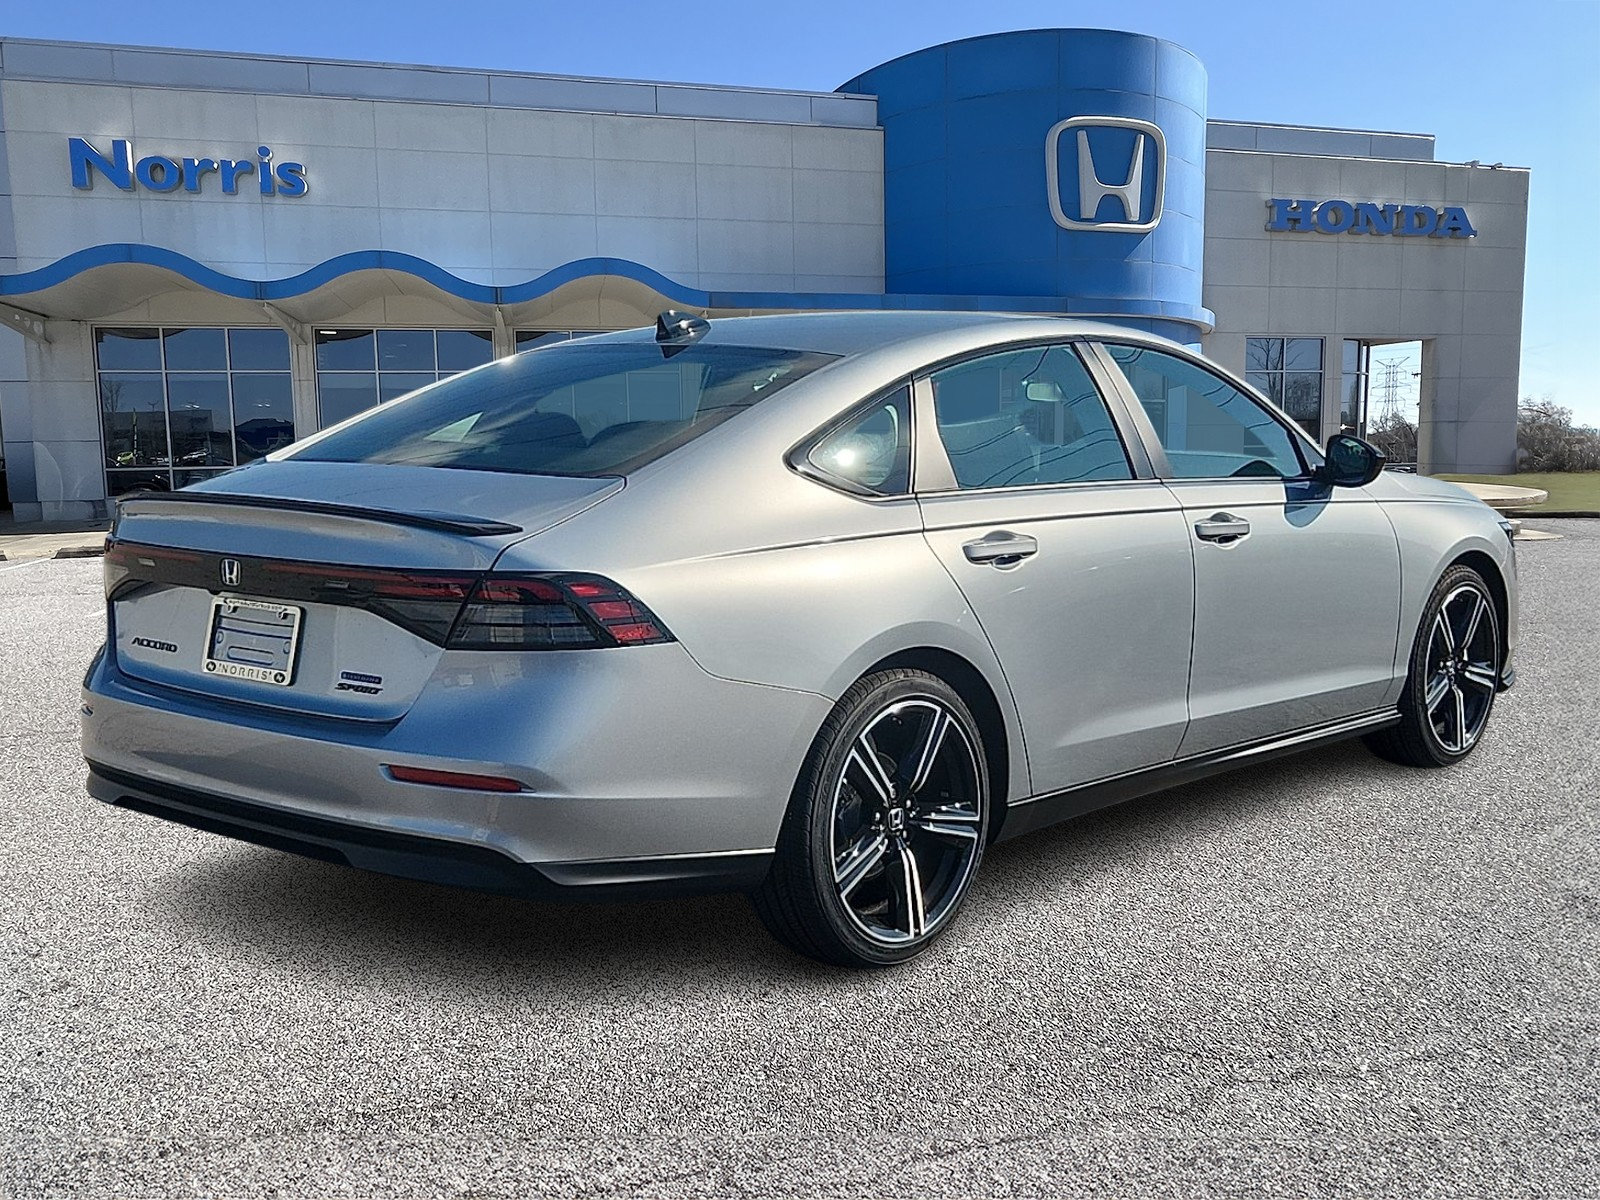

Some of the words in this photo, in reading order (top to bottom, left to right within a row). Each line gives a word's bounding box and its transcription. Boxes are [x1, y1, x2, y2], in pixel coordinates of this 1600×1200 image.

[68, 137, 309, 197] Norris
[1265, 198, 1478, 239] HONDA
[131, 637, 178, 653] ACCORD
[334, 682, 384, 695] SPORT
